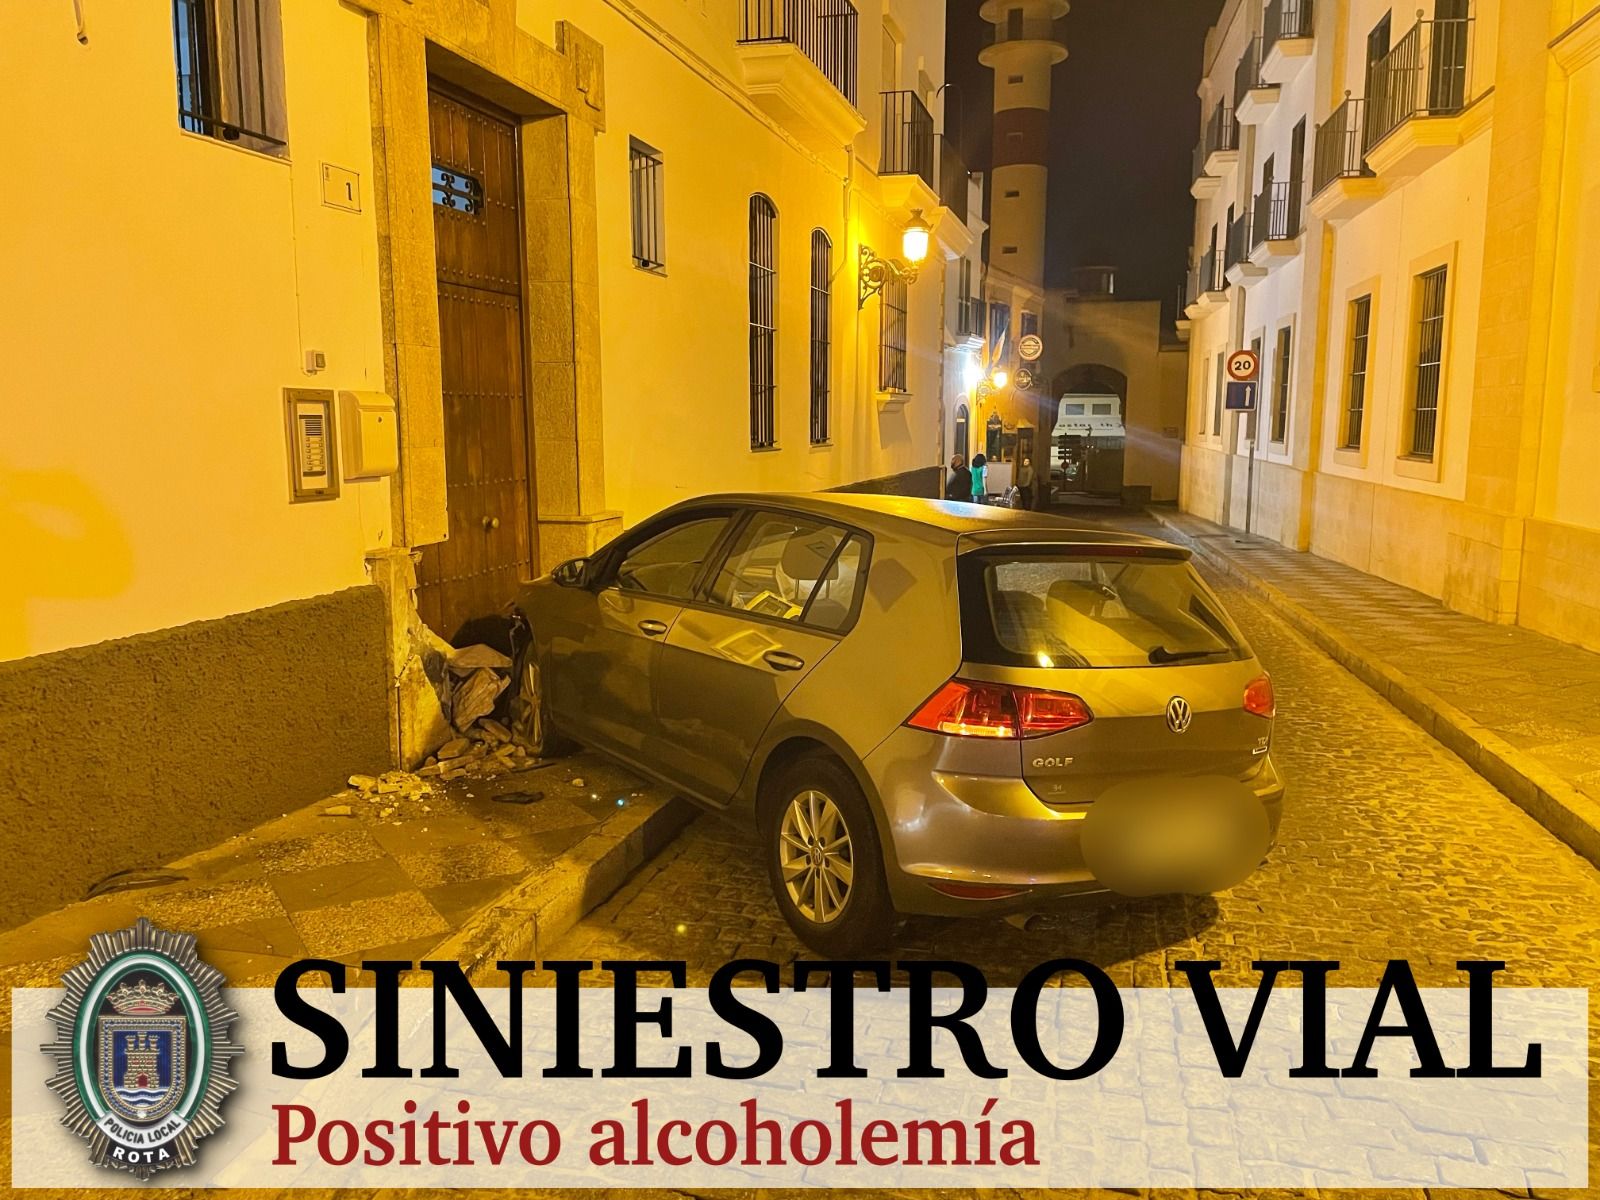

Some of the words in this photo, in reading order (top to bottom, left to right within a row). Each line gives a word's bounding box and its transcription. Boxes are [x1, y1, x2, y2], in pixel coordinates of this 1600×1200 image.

[345, 182, 353, 201] 1
[1234, 360, 1252, 371] 20
[1032, 757, 1074, 768] GOLF
